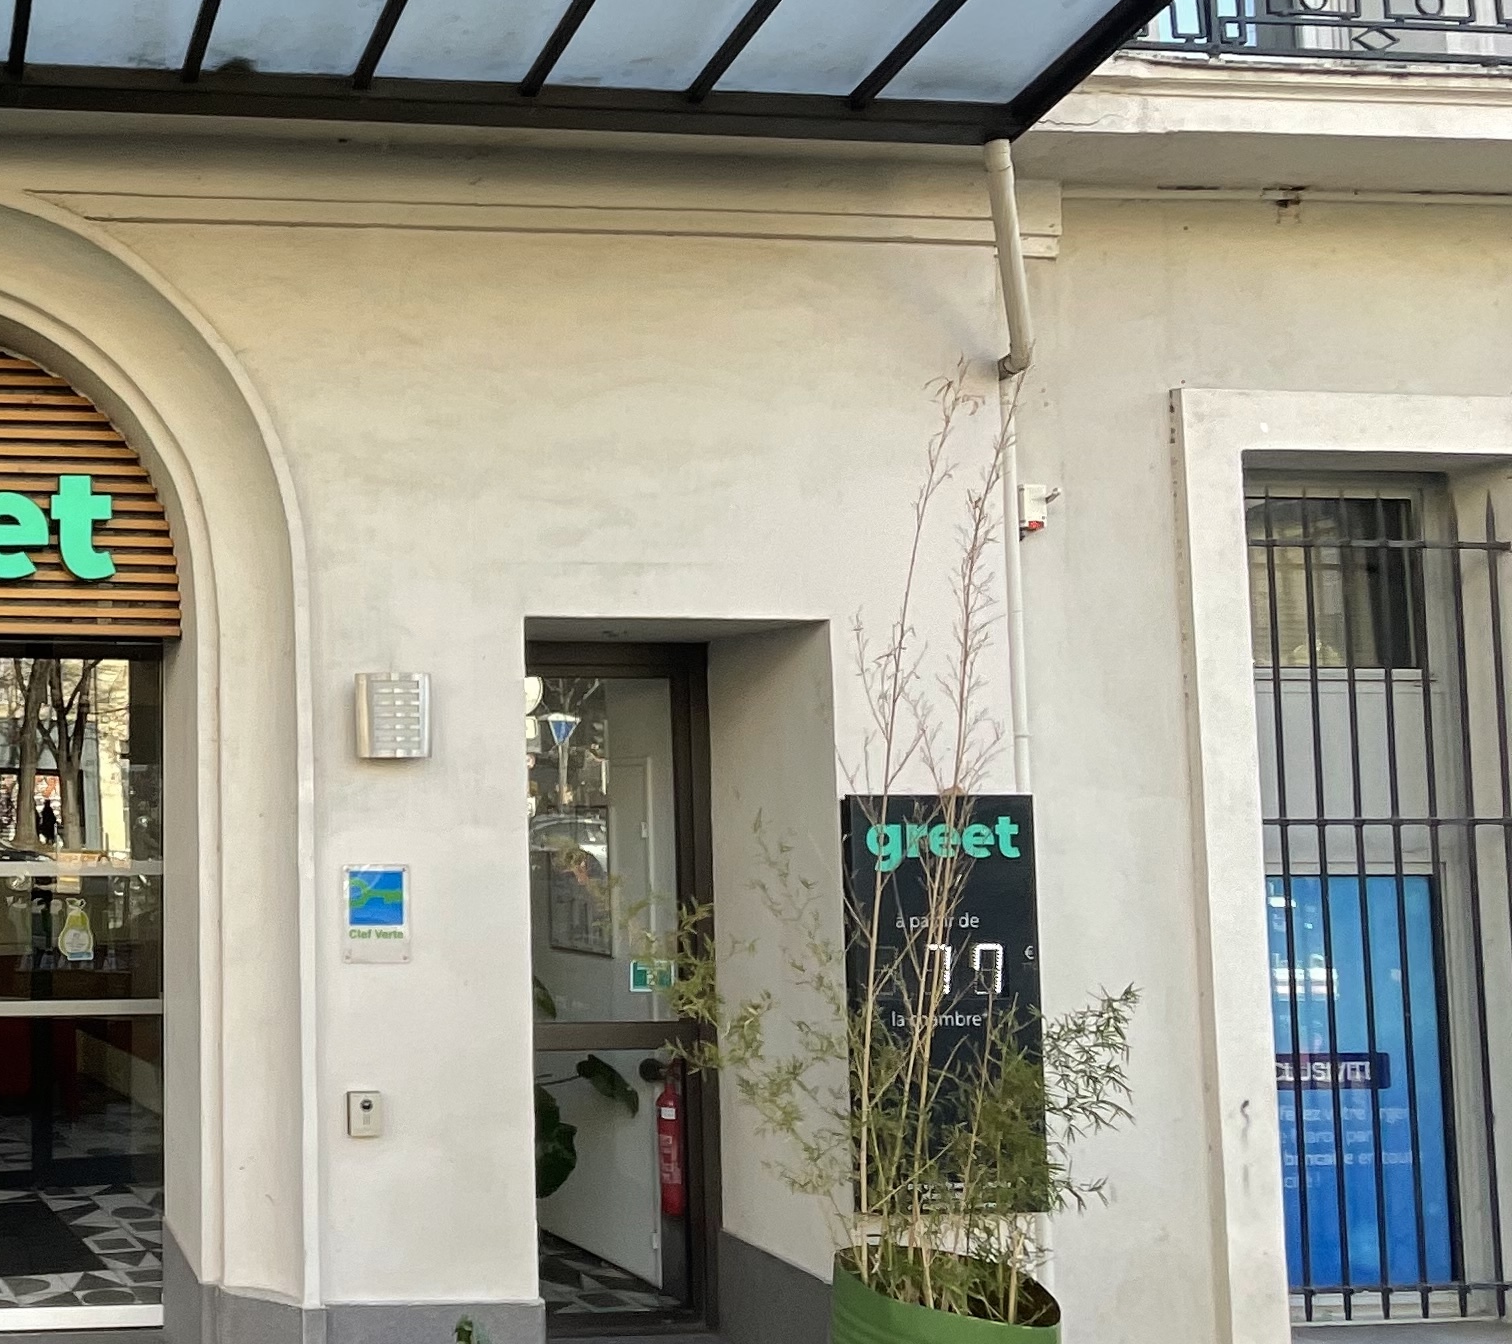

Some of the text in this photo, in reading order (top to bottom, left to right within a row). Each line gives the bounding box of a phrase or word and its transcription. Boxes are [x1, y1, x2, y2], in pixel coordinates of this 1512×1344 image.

[866, 815, 1022, 873] greet
[909, 915, 955, 933] pair
[958, 911, 981, 929] de
[349, 928, 404, 940] Clef Verte
[891, 1010, 905, 1027] la
